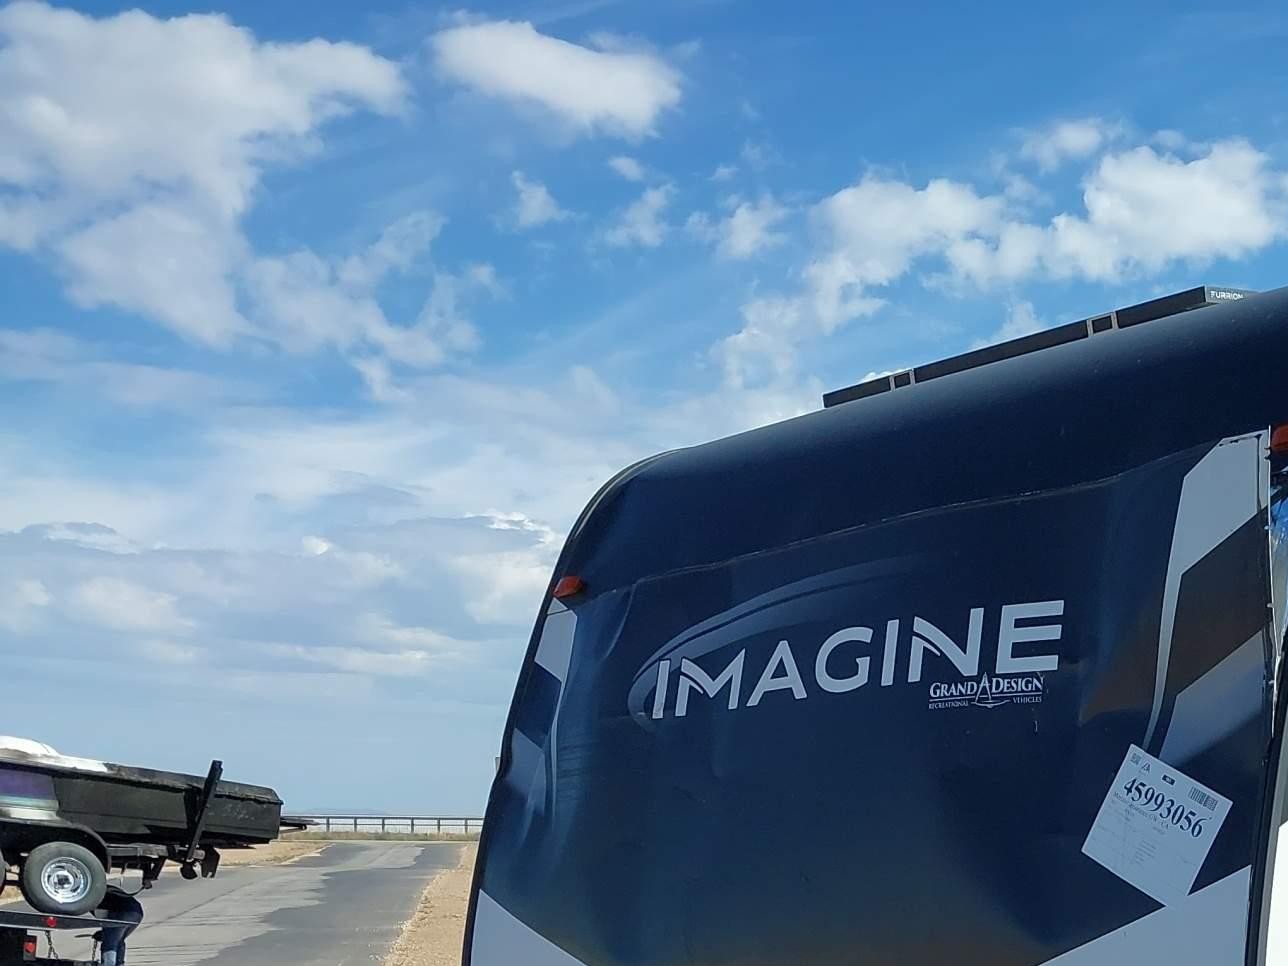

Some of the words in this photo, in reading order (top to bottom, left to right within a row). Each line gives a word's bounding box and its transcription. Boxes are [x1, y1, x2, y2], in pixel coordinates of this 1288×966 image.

[1210, 290, 1244, 301] FURRION
[652, 600, 1065, 719] IMAGINE
[929, 681, 978, 698] GRAND
[991, 676, 1044, 694] DESIGN
[1123, 778, 1209, 838] 45993056
